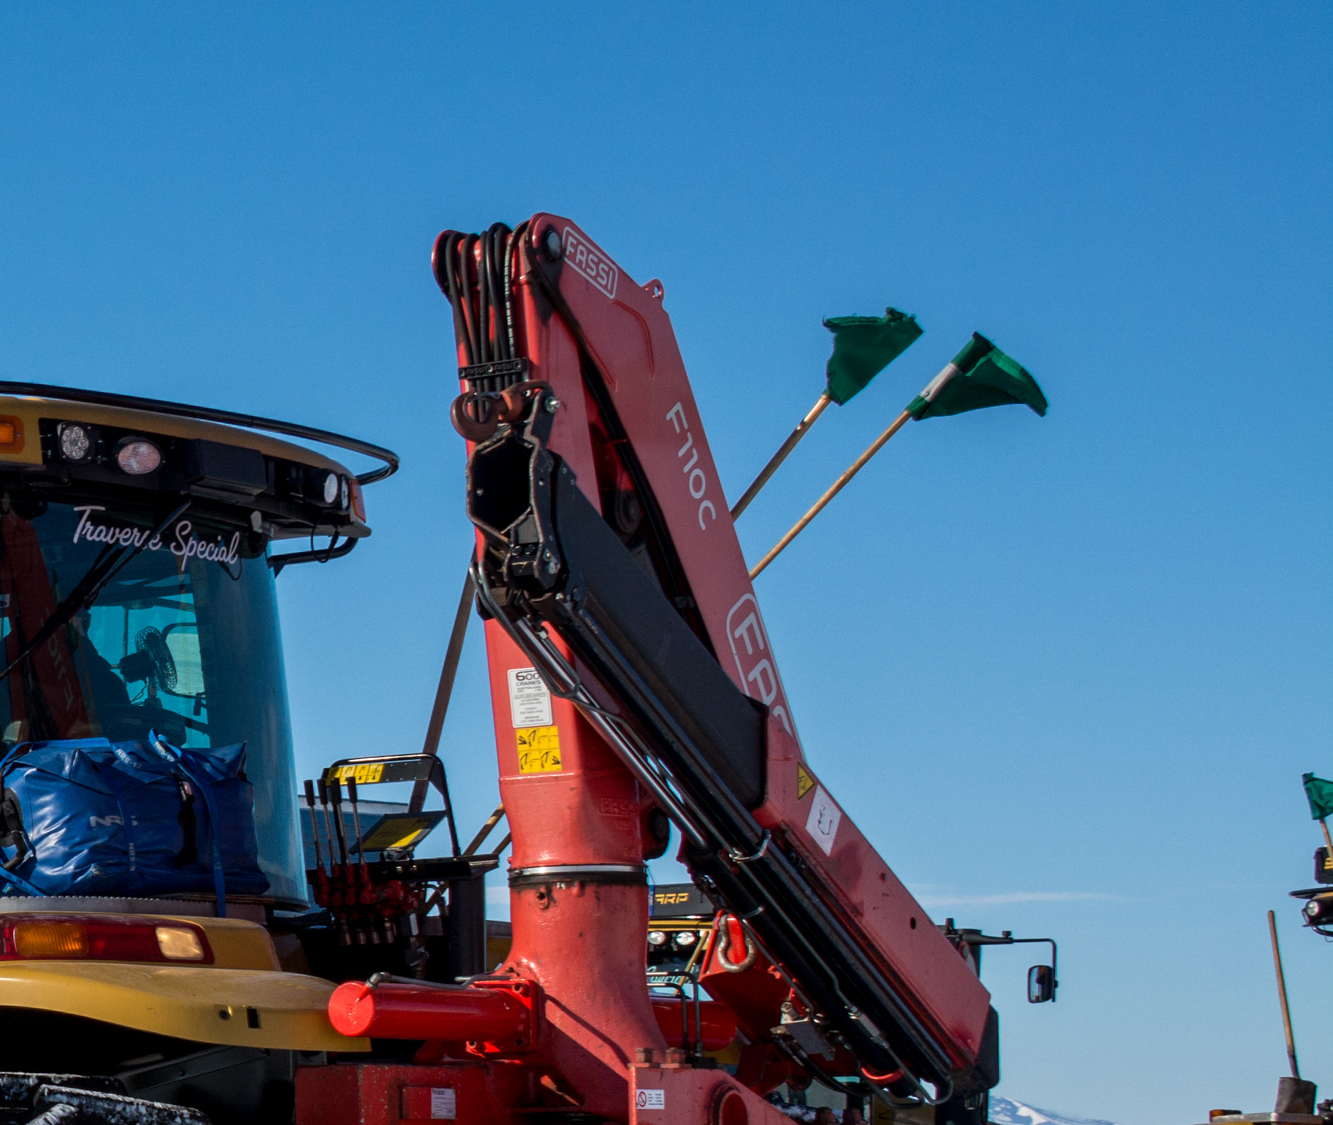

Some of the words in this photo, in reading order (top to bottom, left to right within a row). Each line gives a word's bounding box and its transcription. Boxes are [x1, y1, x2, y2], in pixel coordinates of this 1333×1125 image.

[565, 234, 613, 291] FASSI
[665, 401, 716, 531] F110C
[169, 520, 241, 572] Special
